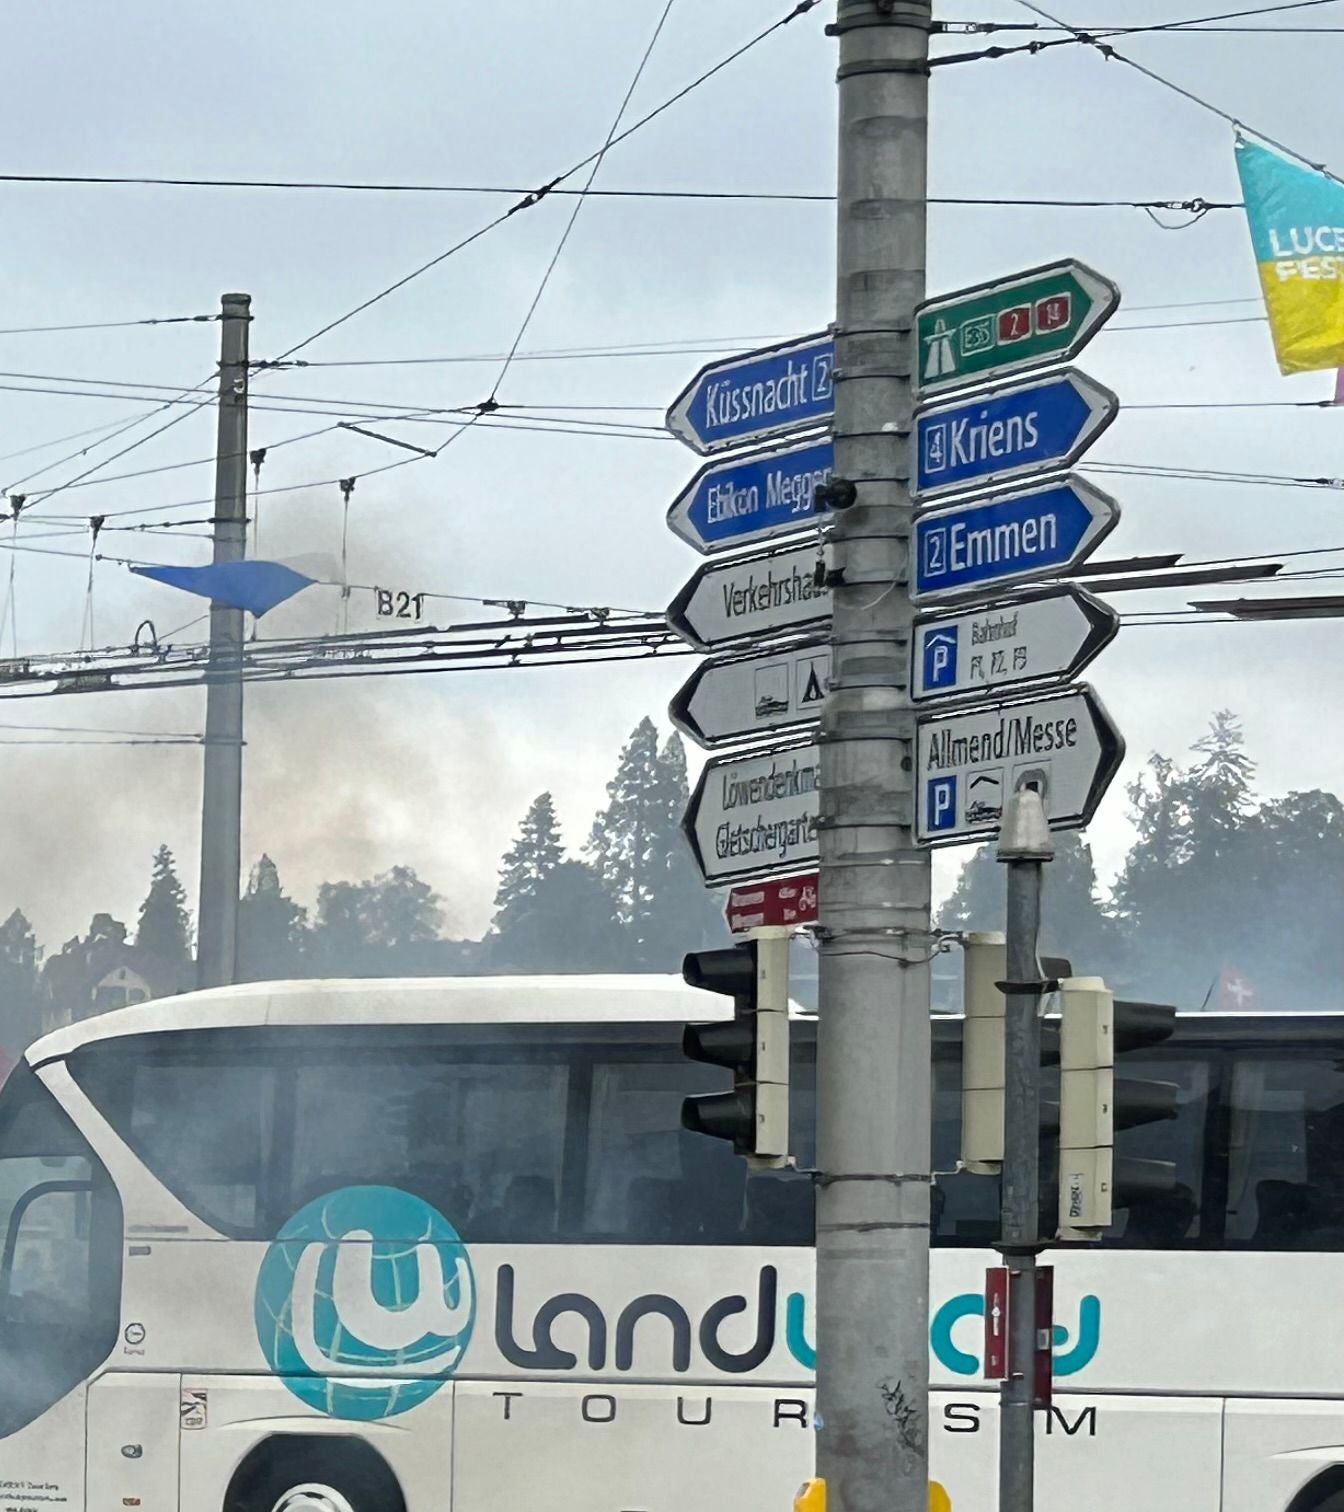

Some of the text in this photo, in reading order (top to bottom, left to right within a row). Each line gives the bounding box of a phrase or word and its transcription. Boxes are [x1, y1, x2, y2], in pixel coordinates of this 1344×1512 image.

[705, 358, 809, 430] Küssnacht
[929, 409, 1039, 469] 4 Kriens
[929, 512, 1057, 572] 2 Emmen
[377, 590, 421, 620] B21
[927, 715, 1078, 771] Allmend/Messe
[492, 1391, 1099, 1437] TOURSM
